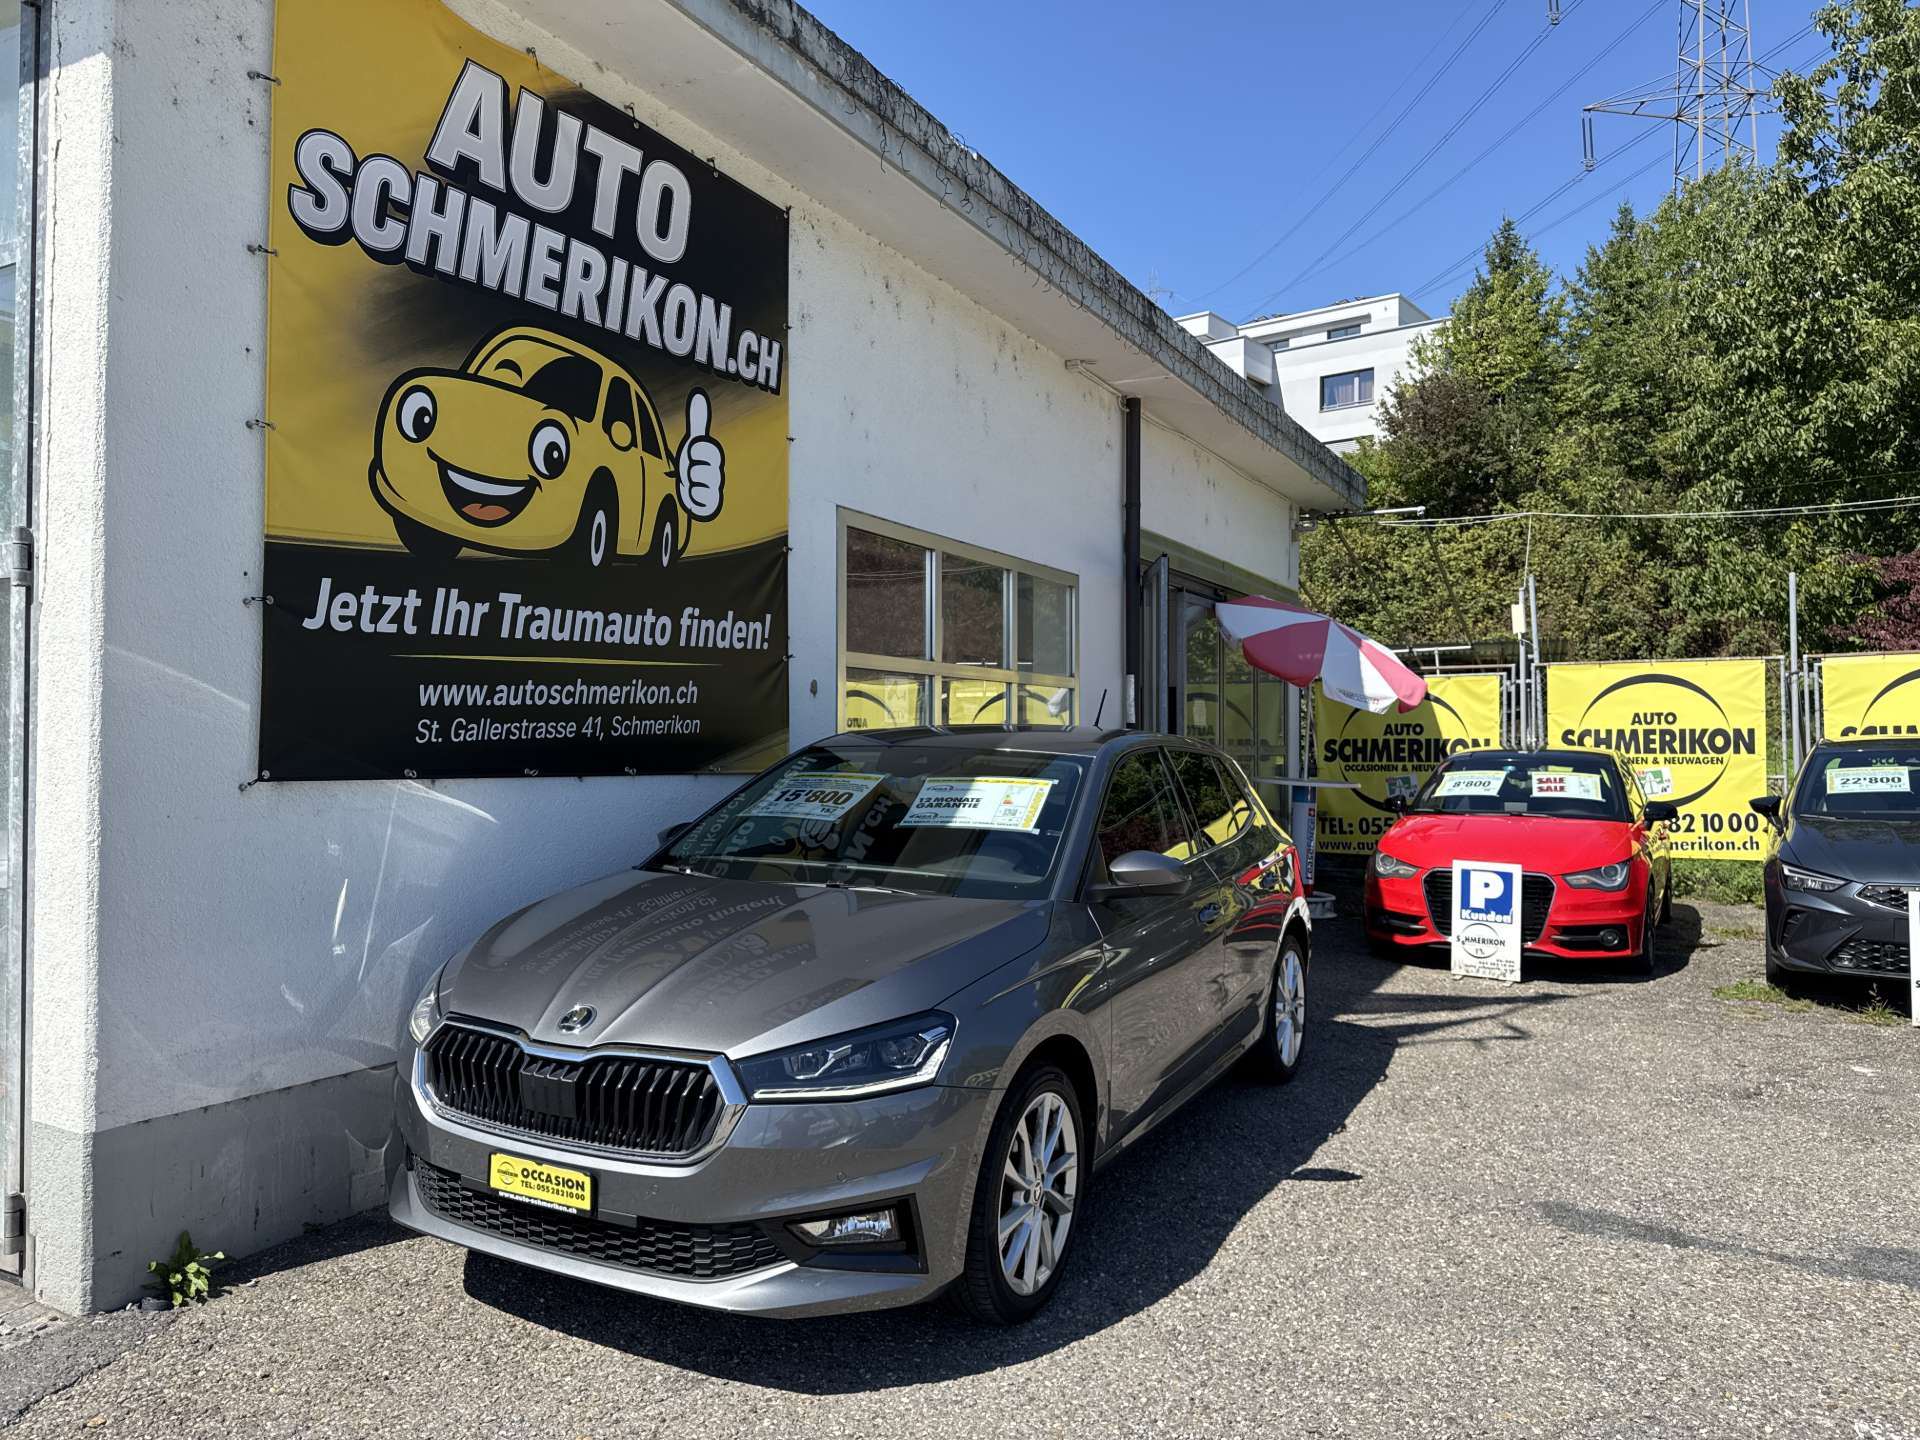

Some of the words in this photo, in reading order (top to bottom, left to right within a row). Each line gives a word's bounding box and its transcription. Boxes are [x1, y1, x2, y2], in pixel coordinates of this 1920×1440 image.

[424, 58, 693, 264] AUTO
[288, 130, 783, 392] SCHMERIKON.CH
[302, 577, 421, 636] Jetzt
[430, 587, 490, 638] Ihr
[498, 592, 672, 647] Traumauto
[680, 606, 772, 650] finden!
[418, 679, 699, 708] www.autoschmerikon.ch
[1631, 712, 1677, 726] AUTO
[415, 719, 444, 744] St.
[450, 716, 577, 743] Gallerstrasse
[581, 715, 604, 740] 41,
[610, 714, 701, 737] Schmerikon
[1383, 723, 1425, 736] AUTO
[1561, 728, 1756, 755] SCHMERIKON
[1344, 764, 1399, 772] OCCASIONEN
[1401, 764, 1409, 772] &
[1652, 757, 1660, 765] &
[1664, 757, 1724, 765] NEUWAGEN
[1452, 780, 1491, 788] 8'800
[1840, 776, 1902, 785] 22'800
[774, 789, 853, 806] 15'800
[1319, 817, 1354, 835] TEL:
[1701, 813, 1723, 833] 10
[1728, 812, 1759, 833] 00
[1469, 870, 1504, 909] P
[1461, 908, 1513, 925] Kunden
[521, 1167, 585, 1192] OCCASION
[521, 1180, 535, 1190] TEL:
